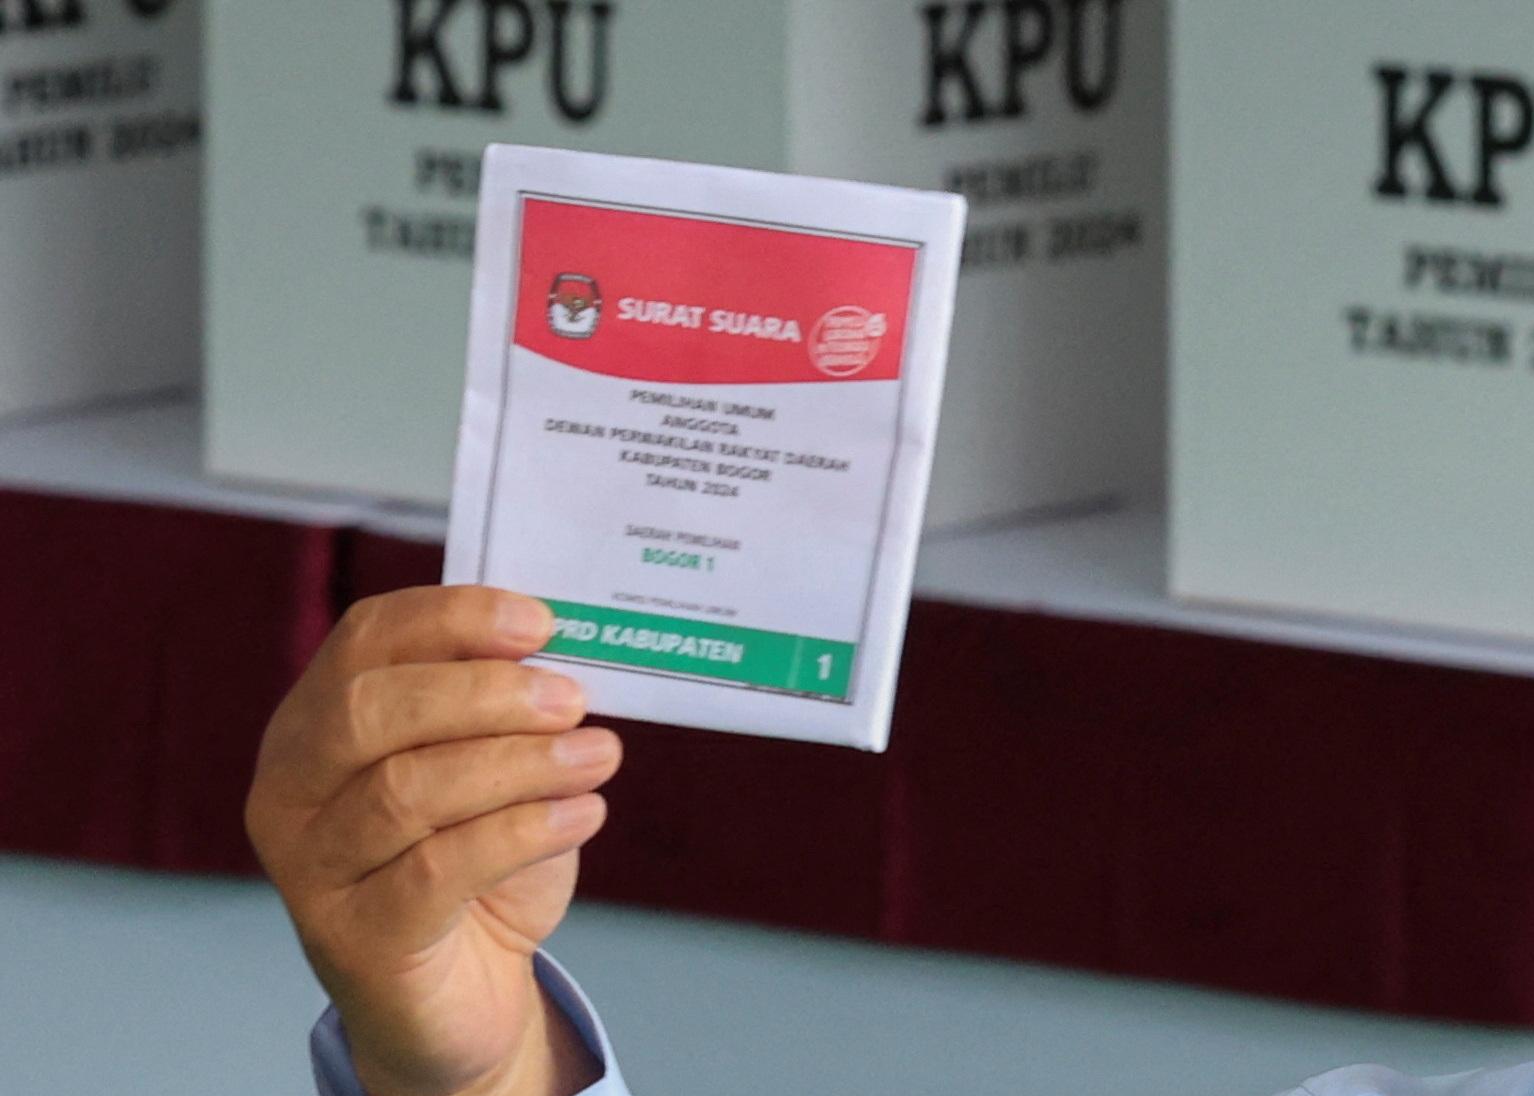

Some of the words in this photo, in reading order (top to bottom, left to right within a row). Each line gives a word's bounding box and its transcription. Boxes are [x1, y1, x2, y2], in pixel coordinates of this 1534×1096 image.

[385, 0, 616, 123] KPU
[918, 0, 1120, 125] KPU
[617, 297, 705, 329] SURAT
[709, 309, 802, 342] SUARA
[1346, 308, 1509, 370] TAHUN
[629, 389, 718, 412] PEMILIHAN
[722, 402, 775, 421] UMUM
[660, 414, 740, 436] ANGGOTA
[544, 418, 605, 438] DEWAN
[783, 452, 850, 472] DAERAH
[618, 449, 712, 473] KABUPATEN
[715, 463, 772, 482] BOGOR
[646, 473, 698, 492] TAHUN
[641, 547, 701, 571] BOGOR
[706, 556, 716, 571] 1
[552, 617, 598, 642] PRD
[600, 624, 744, 664] KABUPATEN
[817, 653, 834, 681] 1
